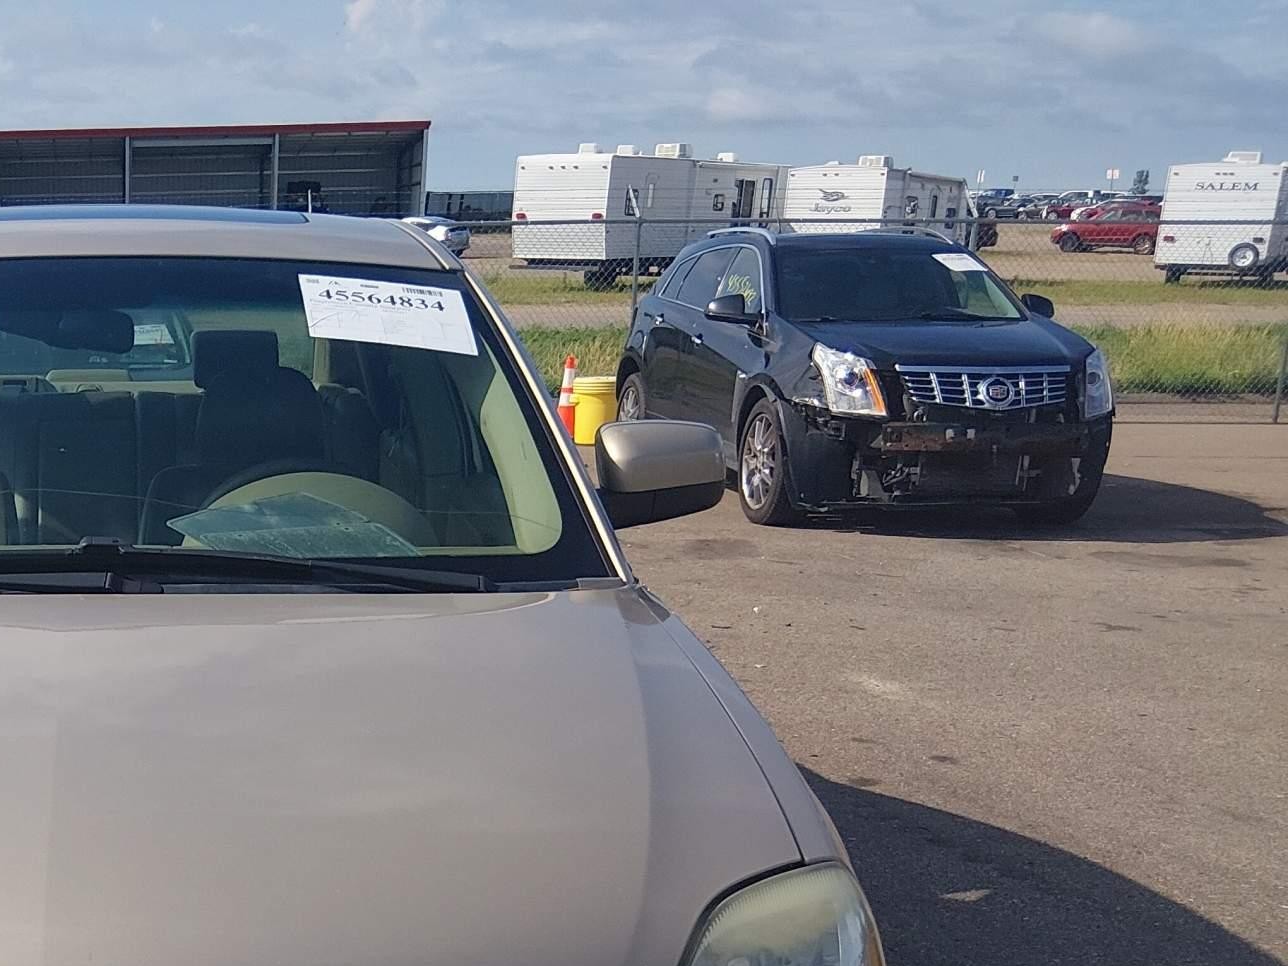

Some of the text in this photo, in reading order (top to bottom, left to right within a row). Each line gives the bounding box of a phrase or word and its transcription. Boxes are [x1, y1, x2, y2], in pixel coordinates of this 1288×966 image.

[1194, 182, 1260, 192] SALEM
[808, 203, 852, 215] Jayco
[318, 288, 446, 312] 45564834
